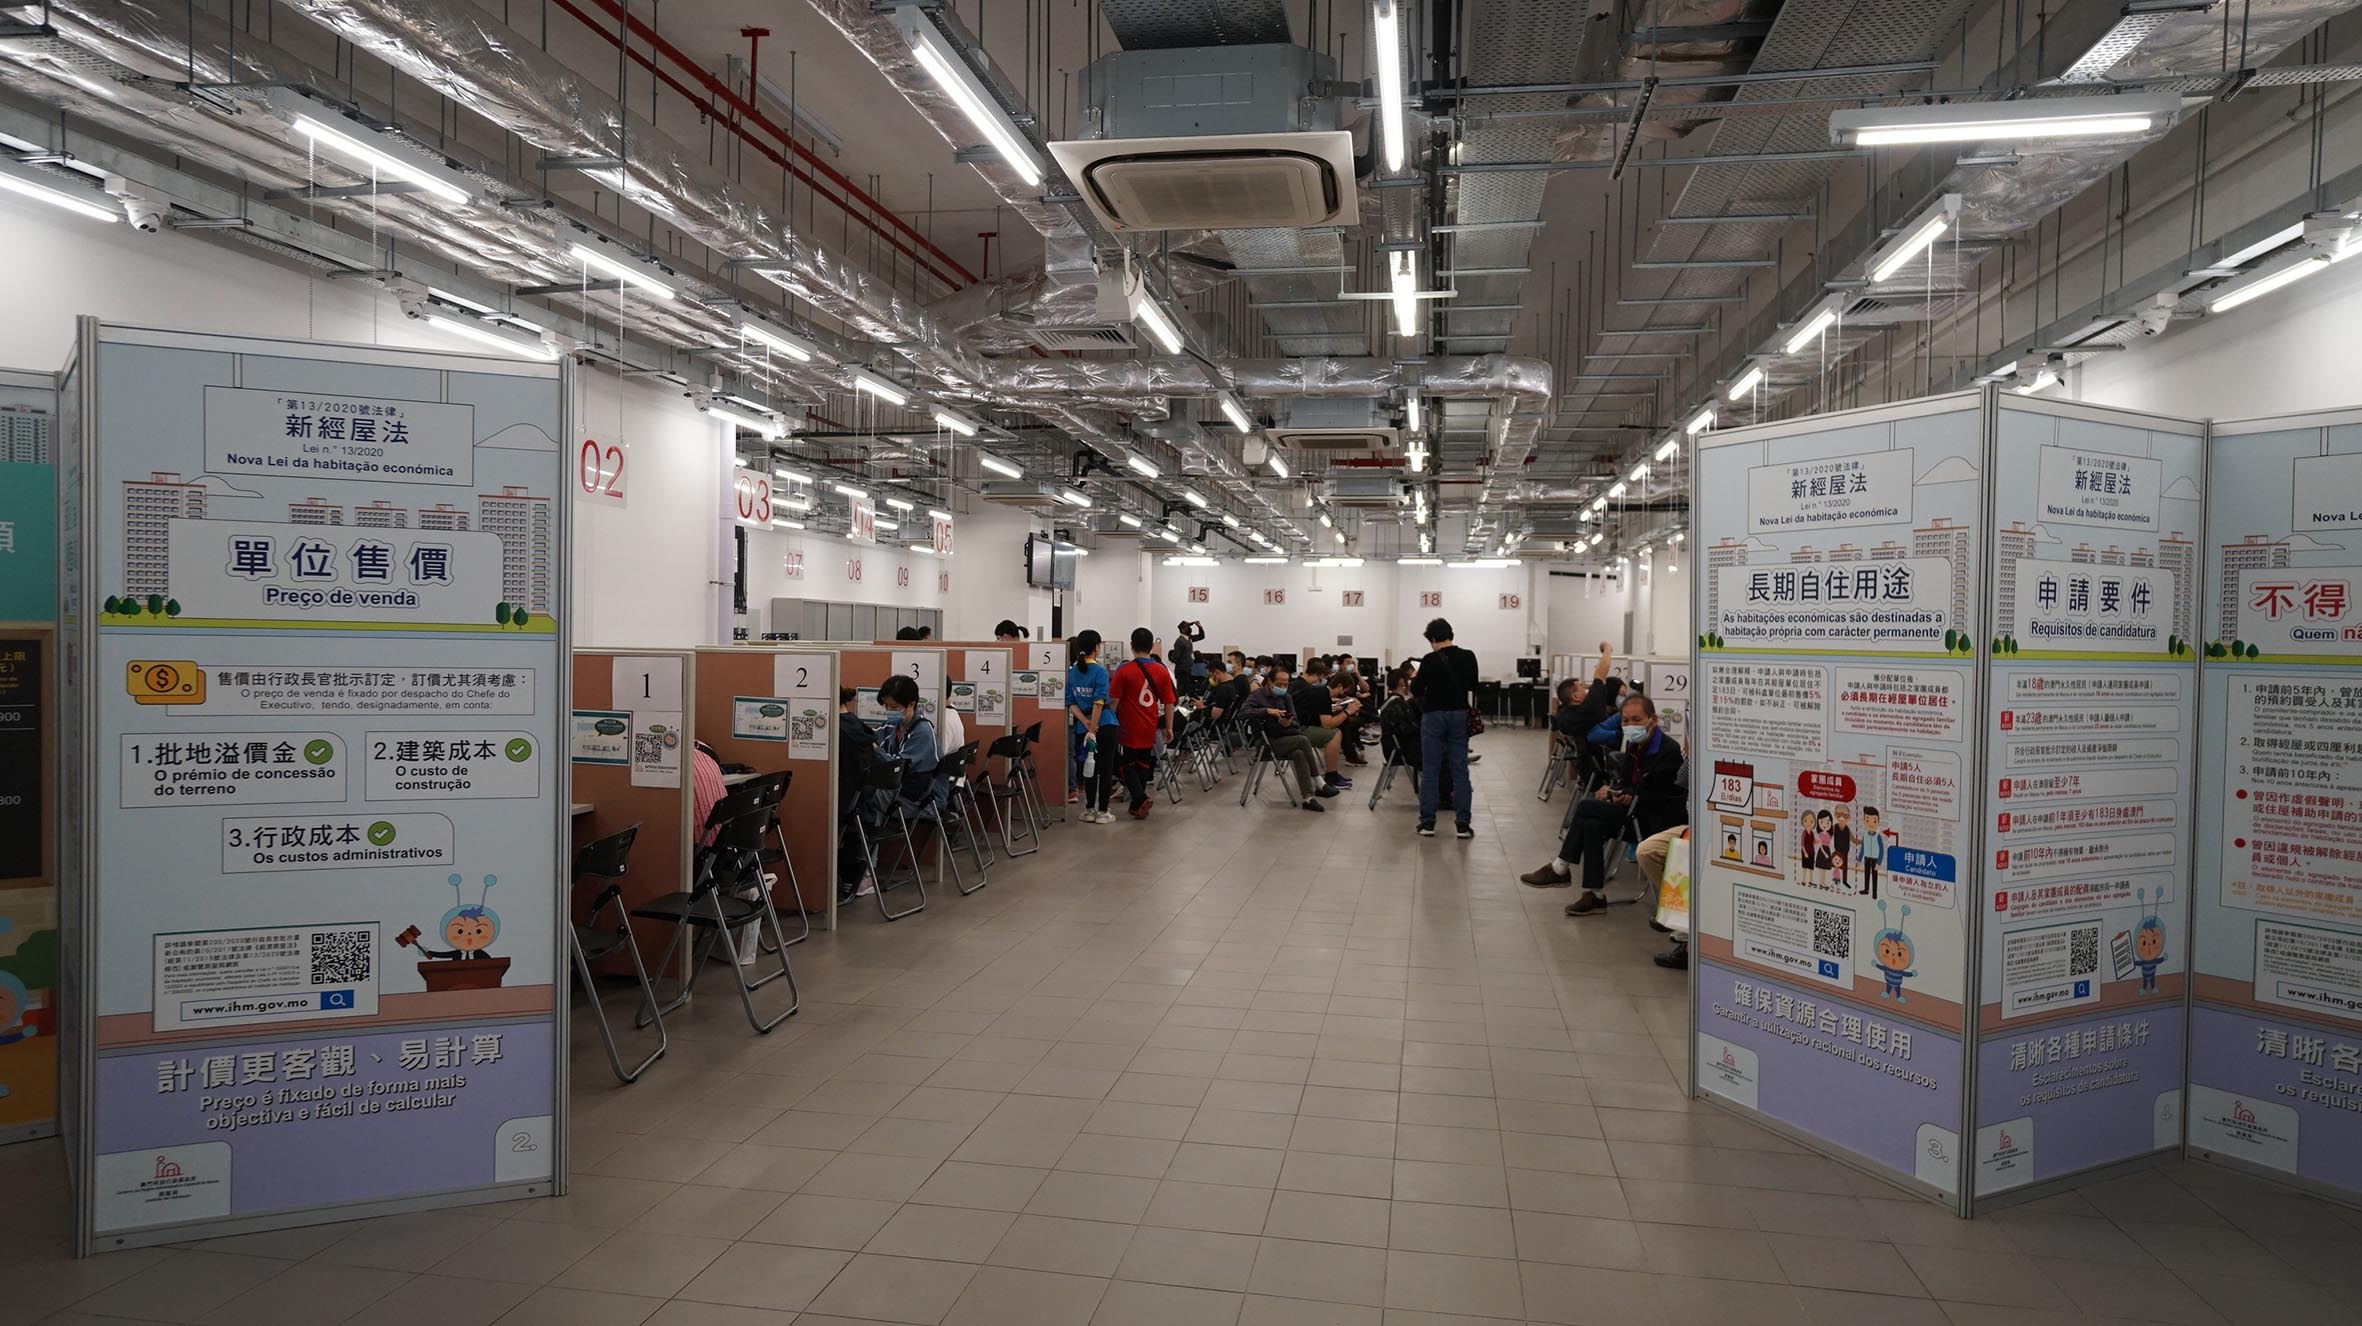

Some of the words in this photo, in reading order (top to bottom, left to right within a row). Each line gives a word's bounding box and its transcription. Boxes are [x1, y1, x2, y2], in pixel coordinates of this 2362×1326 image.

[277, 399, 405, 418] 「第13/2020號法律」
[286, 413, 410, 445] 新經屋法
[303, 443, 320, 453] Lei
[342, 446, 384, 457] 13/2020
[227, 453, 263, 466] Nova
[268, 455, 288, 467] Lei
[293, 457, 309, 469] da
[313, 458, 379, 474] habitação
[382, 461, 454, 476] económica
[580, 439, 623, 498] 02
[1792, 472, 1867, 499] 新經屋法
[2075, 469, 2131, 495] 新經屋法
[738, 476, 770, 522] 03
[1801, 502, 1811, 510] Lei
[1824, 498, 1851, 508] 13/2020
[854, 502, 873, 539] 04
[1760, 517, 1779, 526] Nova
[1781, 515, 1793, 524] Lei
[1795, 515, 1805, 523] da
[1807, 512, 1847, 522] habitação
[1849, 507, 1898, 519] económica
[2047, 504, 2064, 515] Nova
[2065, 507, 2075, 516] Lei
[2076, 508, 2084, 517] da
[2085, 509, 2116, 520] habitação
[2117, 512, 2150, 523] económica
[2312, 513, 2345, 522] Nova
[936, 522, 952, 553] 05
[233, 540, 448, 581] 單位售價
[786, 553, 802, 576] 07
[848, 560, 862, 580] 08
[897, 566, 909, 587] 09
[939, 573, 949, 592] 10
[1749, 567, 1910, 601] 長期自住用途
[267, 588, 323, 607] Preço
[331, 590, 353, 604] de
[359, 591, 416, 606] venda
[1190, 588, 1208, 601] 15
[1265, 590, 1283, 603] 16
[1344, 592, 1362, 605] 17
[1422, 593, 1440, 606] 18
[1500, 595, 1519, 608] 19
[2038, 577, 2151, 614] 申請要件
[2255, 583, 2346, 618] 不得
[1724, 613, 1735, 623] As
[1737, 612, 1785, 624] habitações
[1788, 612, 1846, 623] económicas
[1849, 611, 1869, 623] são
[1871, 611, 1930, 623] destinadas
[1933, 614, 1942, 622] a
[1725, 626, 1767, 638] habitação
[1769, 627, 1802, 639] própria
[1805, 629, 1826, 637] com
[1828, 627, 1870, 637] carácter
[1873, 627, 1940, 639] permanente
[2031, 621, 2082, 639] Requisitos
[2085, 623, 2097, 637] de
[2100, 623, 2156, 638] candidatura
[2293, 628, 2335, 641] Quem
[980, 660, 990, 675] 4
[1043, 651, 1051, 665] 5
[796, 667, 808, 688] 2
[910, 662, 920, 680] 3
[642, 673, 651, 698] 1
[1664, 675, 1687, 691] 29
[241, 689, 250, 698] O
[254, 690, 283, 699] preço
[287, 689, 300, 698] de
[304, 689, 335, 698] venda
[338, 689, 344, 698] é
[348, 689, 379, 698] fixado
[382, 691, 397, 700] por
[401, 689, 449, 700] despacho
[451, 689, 464, 698] do
[466, 689, 495, 698] Chefe
[498, 689, 510, 698] do
[1139, 679, 1154, 707] 6
[261, 701, 315, 710] Executivo,
[322, 701, 353, 710] tendo,
[357, 701, 442, 711] designadamente,
[2240, 737, 2249, 746] 2.
[155, 770, 167, 781] O
[173, 769, 226, 783] prémio
[232, 768, 250, 780] de
[255, 767, 335, 779] concessão
[396, 766, 406, 776] O
[411, 766, 448, 776] custo
[452, 765, 468, 775] de
[2240, 766, 2248, 775] 3.
[155, 784, 174, 796] do
[180, 784, 236, 795] terreno
[396, 779, 471, 791] construção
[1721, 778, 1741, 791] 183
[253, 852, 274, 864] Os
[279, 850, 328, 863] custos
[333, 848, 443, 861] administrativos
[1905, 851, 1937, 868] 申請人
[1906, 865, 1936, 876] Candidato
[1751, 945, 1812, 968] www.ihm.gov.mo
[2018, 989, 2069, 1003] www.ihm.gov.mo
[193, 999, 308, 1015] www.ihm.gov.mo
[1735, 981, 1913, 1061] 確保資源合理使用
[1712, 1001, 1751, 1026] Garantir
[1753, 1017, 1759, 1027] a
[1761, 1018, 1810, 1045] utilização
[1811, 1038, 1855, 1061] racional
[1859, 1051, 1880, 1069] dos
[1883, 1060, 1938, 1090] recursos
[2010, 1019, 2150, 1072] 清晰各種申請條件
[2257, 1027, 2362, 1073] 清晰各
[158, 1033, 504, 1093] 計價更客觀、易計算
[2032, 1063, 2103, 1087] Esclarecimentos
[2104, 1057, 2128, 1069] sobre
[201, 1092, 257, 1113] Preço
[261, 1089, 273, 1105] é
[278, 1084, 335, 1104] fixado
[341, 1081, 363, 1098] de
[367, 1078, 421, 1096] forma
[425, 1073, 466, 1090] mais
[2020, 1097, 2031, 1107] os
[2033, 1086, 2076, 1105] requisitos
[2079, 1081, 2090, 1093] de
[2091, 1071, 2140, 1091] candidatura
[2275, 1083, 2297, 1096] os
[207, 1108, 294, 1132] objectiva
[300, 1107, 309, 1120] e
[314, 1101, 354, 1119] fácil
[359, 1099, 380, 1115] de
[385, 1092, 456, 1112] calcular
[512, 1132, 538, 1152] 2.
[1928, 1138, 1949, 1163] 3.
